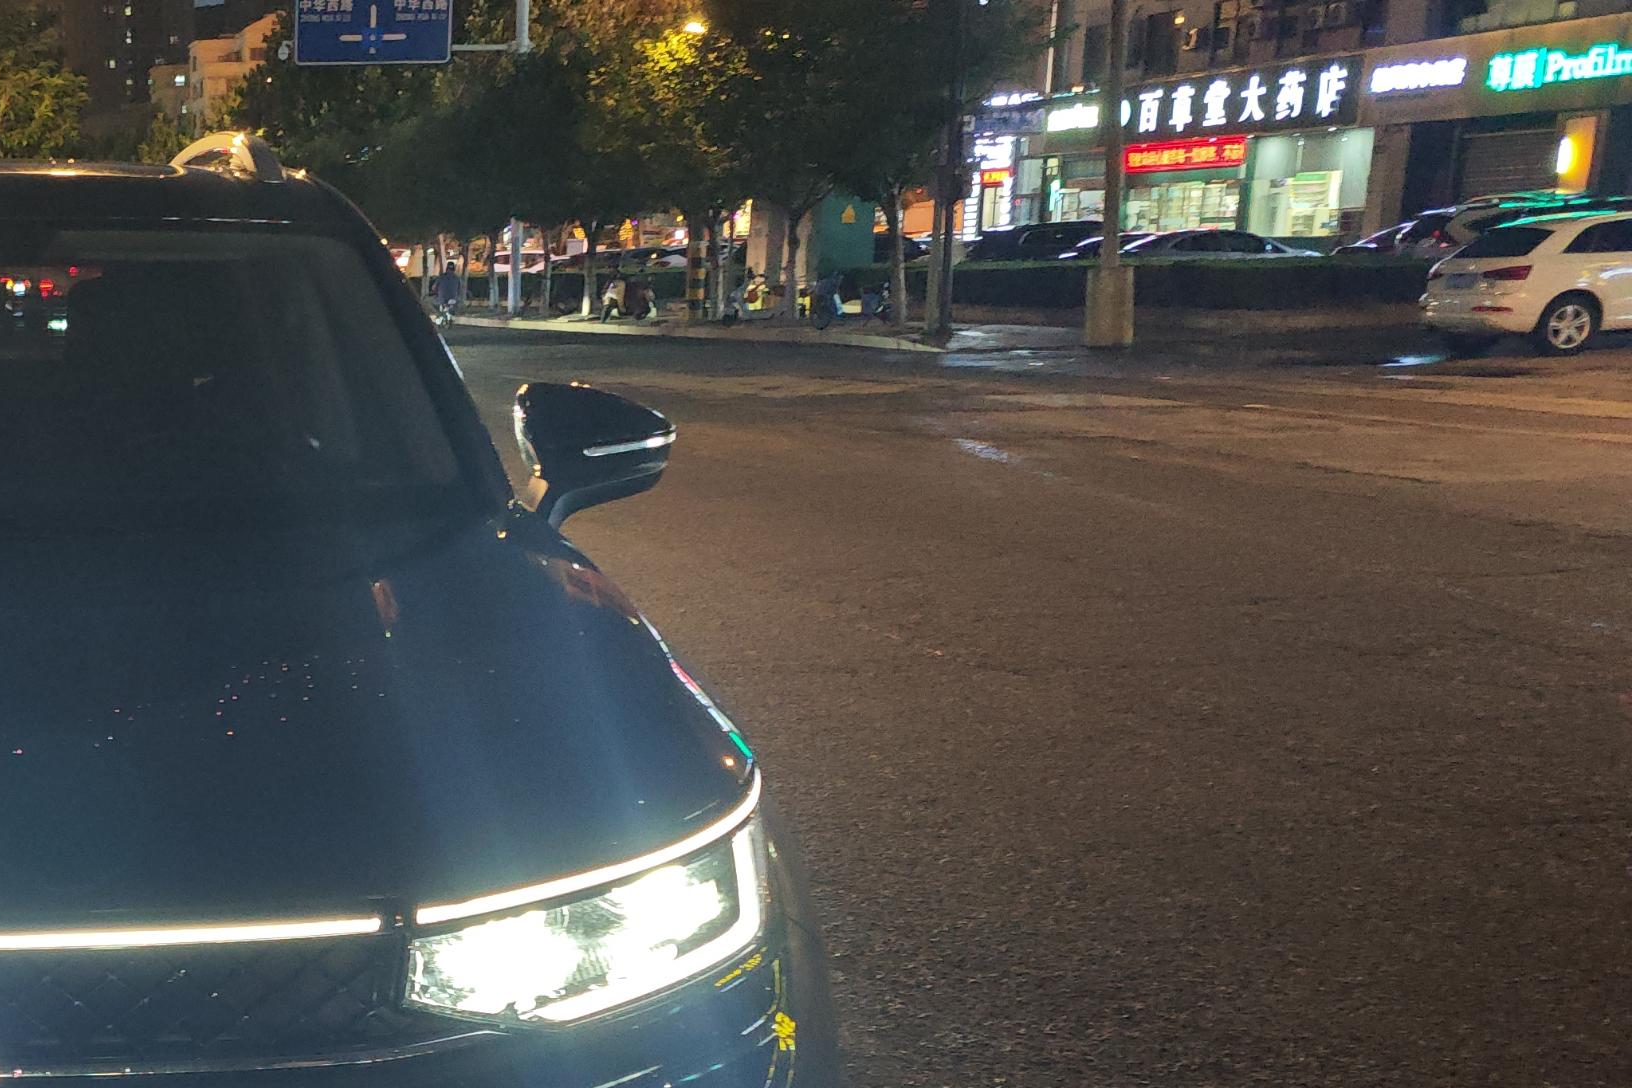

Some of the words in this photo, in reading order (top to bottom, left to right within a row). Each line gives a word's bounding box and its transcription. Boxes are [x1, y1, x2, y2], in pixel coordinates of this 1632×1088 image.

[1137, 63, 1349, 133] 百草堂大药店
